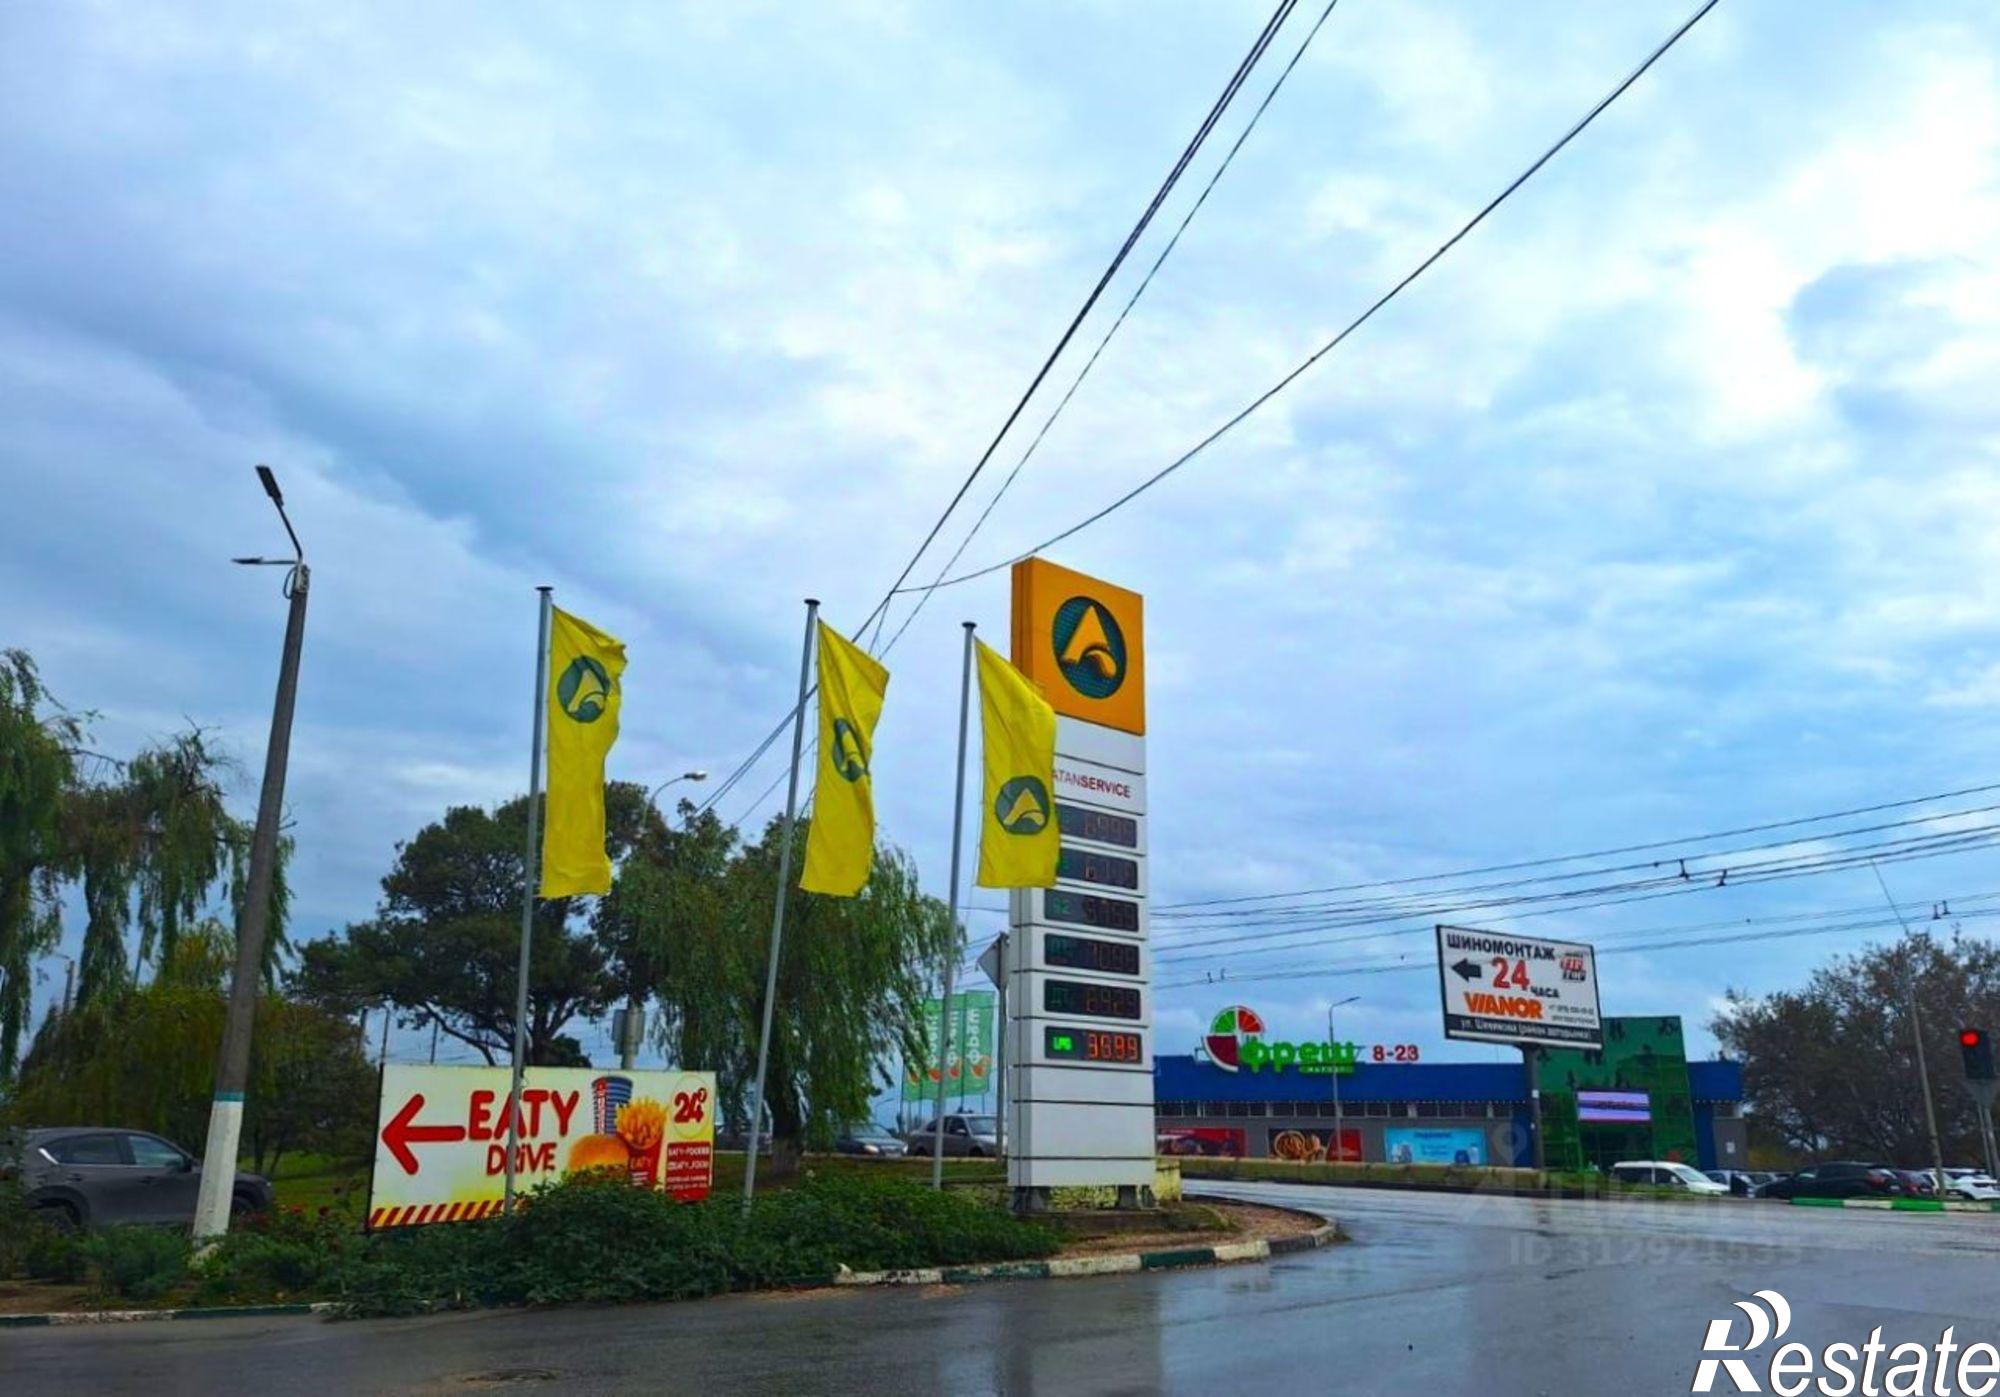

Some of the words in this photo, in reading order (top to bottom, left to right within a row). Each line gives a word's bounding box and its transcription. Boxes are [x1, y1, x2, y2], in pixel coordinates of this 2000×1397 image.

[1446, 933, 1555, 961] ШИНОМОНТАЖ
[1491, 956, 1530, 991] 24
[1530, 985, 1560, 998] ЧАСА
[1464, 991, 1543, 1020] VIANOR
[1372, 1043, 1420, 1062] 8-23
[468, 1089, 580, 1141] EATY
